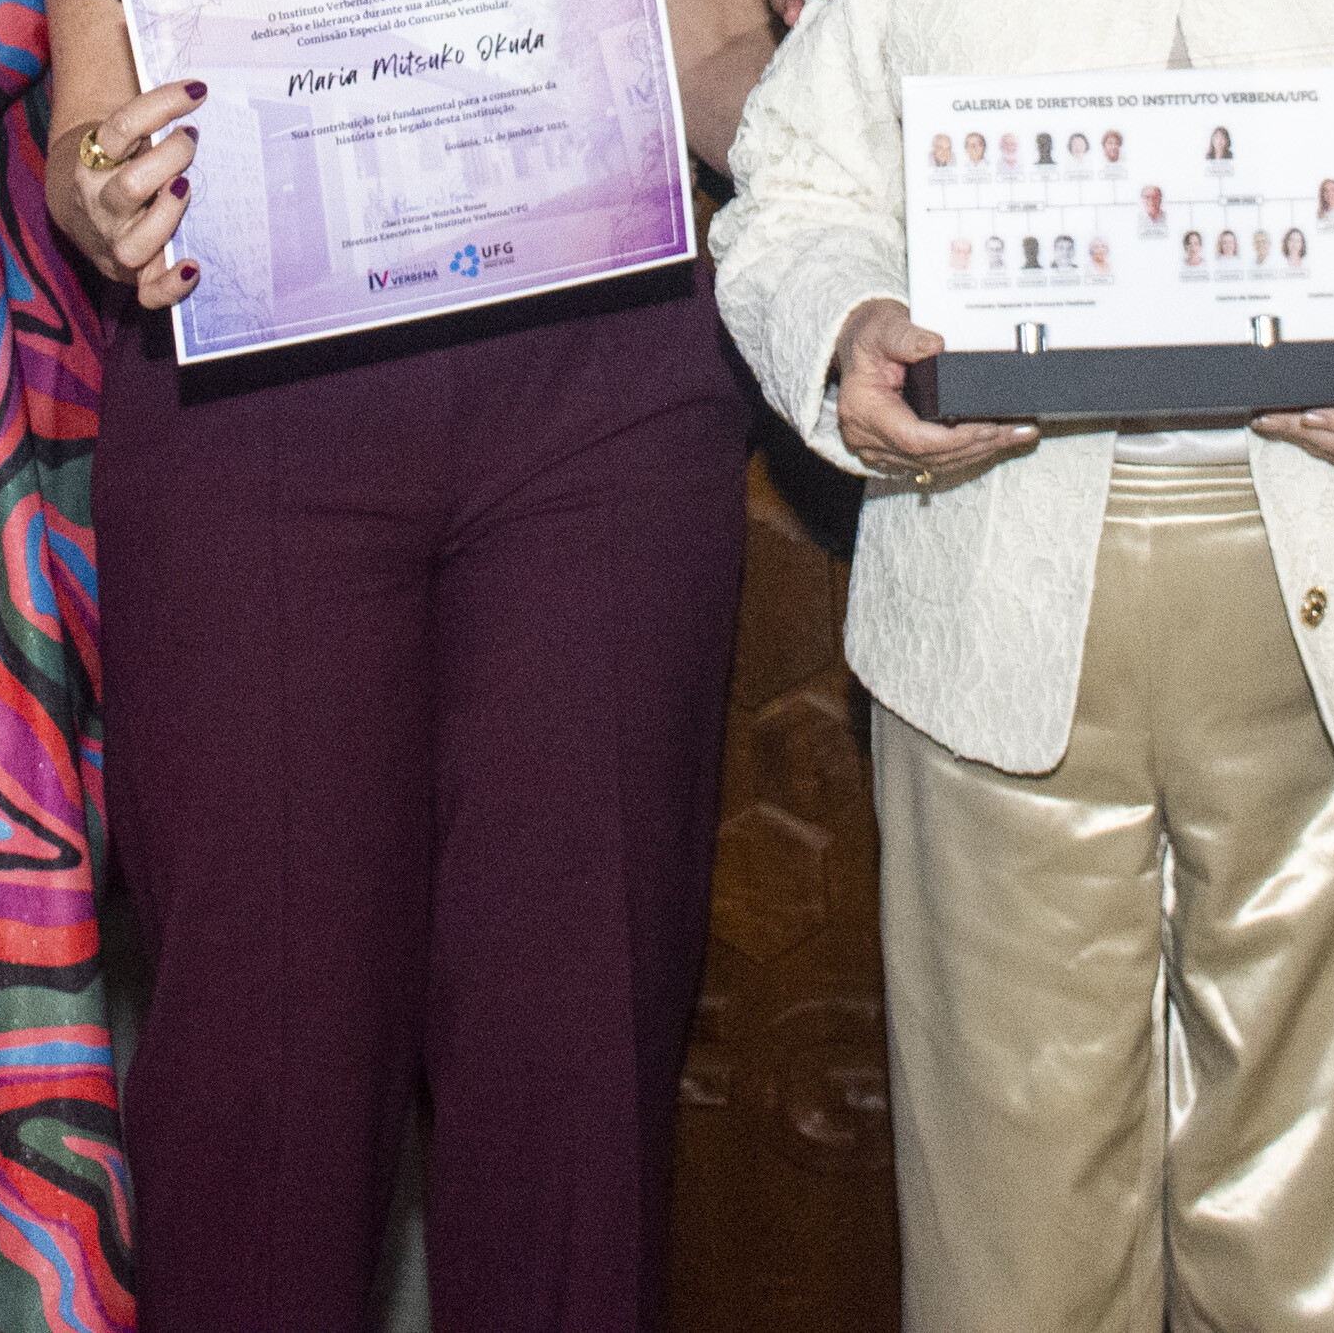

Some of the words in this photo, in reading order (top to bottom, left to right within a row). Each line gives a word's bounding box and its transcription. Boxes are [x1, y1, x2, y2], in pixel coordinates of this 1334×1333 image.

[251, 23, 303, 41] dedicação
[305, 23, 311, 31] e
[313, 13, 360, 29] liderança
[363, 4, 402, 19] durante
[405, 2, 422, 12] sua
[268, 13, 276, 22] O
[278, 5, 324, 21] Instituto
[297, 29, 347, 47] Comissão
[349, 21, 391, 38] Especial
[394, 18, 406, 29] do
[408, 10, 456, 26] Concurso
[458, 0, 513, 16] Vestibular.
[288, 67, 358, 97] Maria
[371, 43, 465, 81] Mitsuko
[477, 28, 545, 62] Okuda
[291, 128, 309, 140] Sua
[311, 115, 374, 136] contribuição
[377, 112, 390, 123] foi
[392, 99, 455, 120] fundamental
[458, 97, 480, 110] para
[482, 95, 488, 103] a
[489, 84, 543, 102] construção
[544, 79, 557, 90] da
[952, 98, 1011, 111] GALERIA
[1015, 98, 1033, 110] DE
[1037, 96, 1113, 109] DIRETORES
[1117, 95, 1138, 107] DO
[1142, 93, 1218, 107] INSTITUTO
[336, 130, 375, 145] história
[385, 125, 397, 135] do
[399, 119, 432, 134] legado
[434, 115, 460, 126] desta
[507, 127, 532, 141] junho
[534, 125, 544, 134] de
[482, 241, 513, 259] UFG
